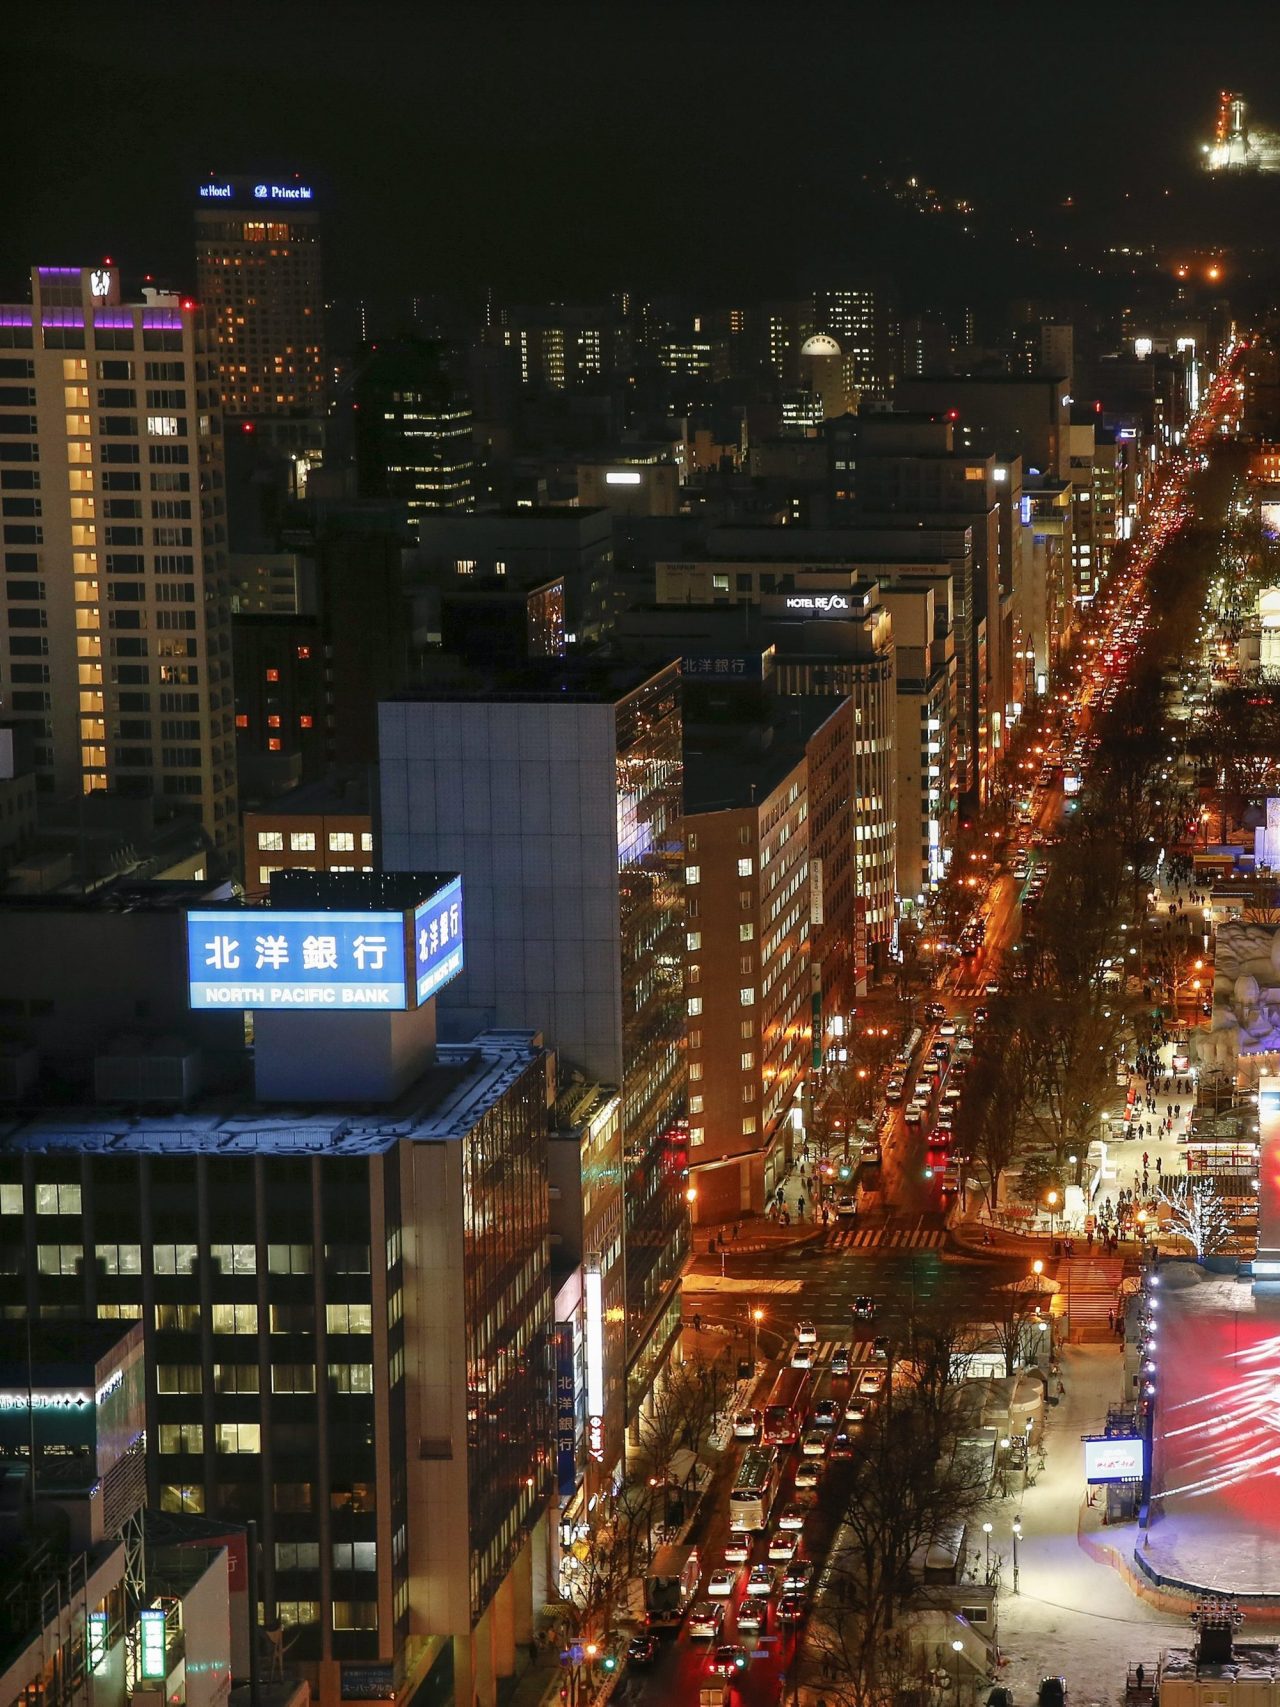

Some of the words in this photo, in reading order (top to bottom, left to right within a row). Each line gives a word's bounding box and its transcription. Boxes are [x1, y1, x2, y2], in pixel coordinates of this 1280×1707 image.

[209, 185, 231, 197] Hotel
[272, 186, 300, 198] Prince
[786, 598, 815, 608] HOTEL
[815, 594, 849, 611] RESOL
[683, 658, 745, 673] 北洋銀行
[419, 902, 459, 963] 北洋銀行
[204, 935, 388, 970] 北洋銀行
[205, 987, 265, 1003] NORTH
[270, 988, 336, 1003] PACIFIC
[341, 988, 390, 1003] BANK
[558, 1376, 574, 1452] 北洋銀行
